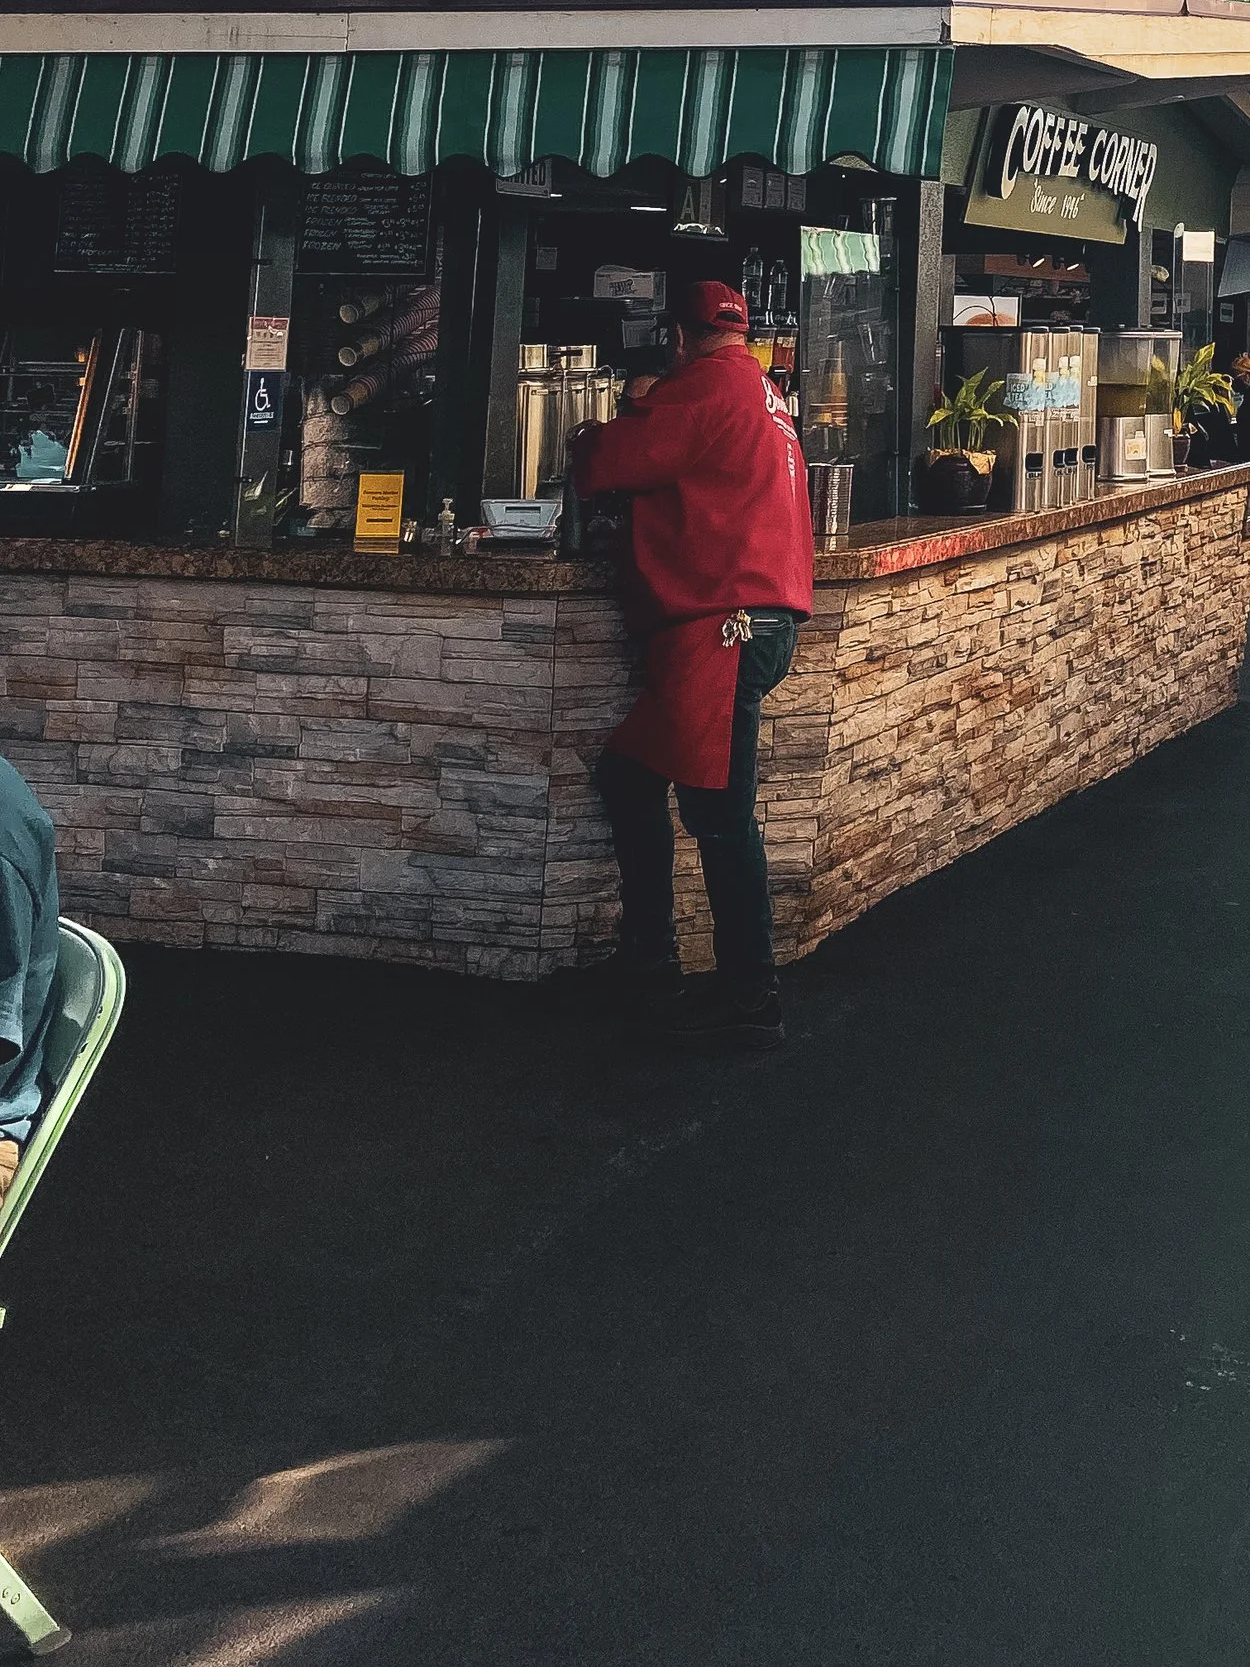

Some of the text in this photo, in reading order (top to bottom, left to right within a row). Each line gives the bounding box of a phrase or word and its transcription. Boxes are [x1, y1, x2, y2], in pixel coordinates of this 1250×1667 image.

[1001, 105, 1158, 232] COFFEE CORNER
[1010, 383, 1026, 393] ICED
[1011, 392, 1025, 402] TEA
